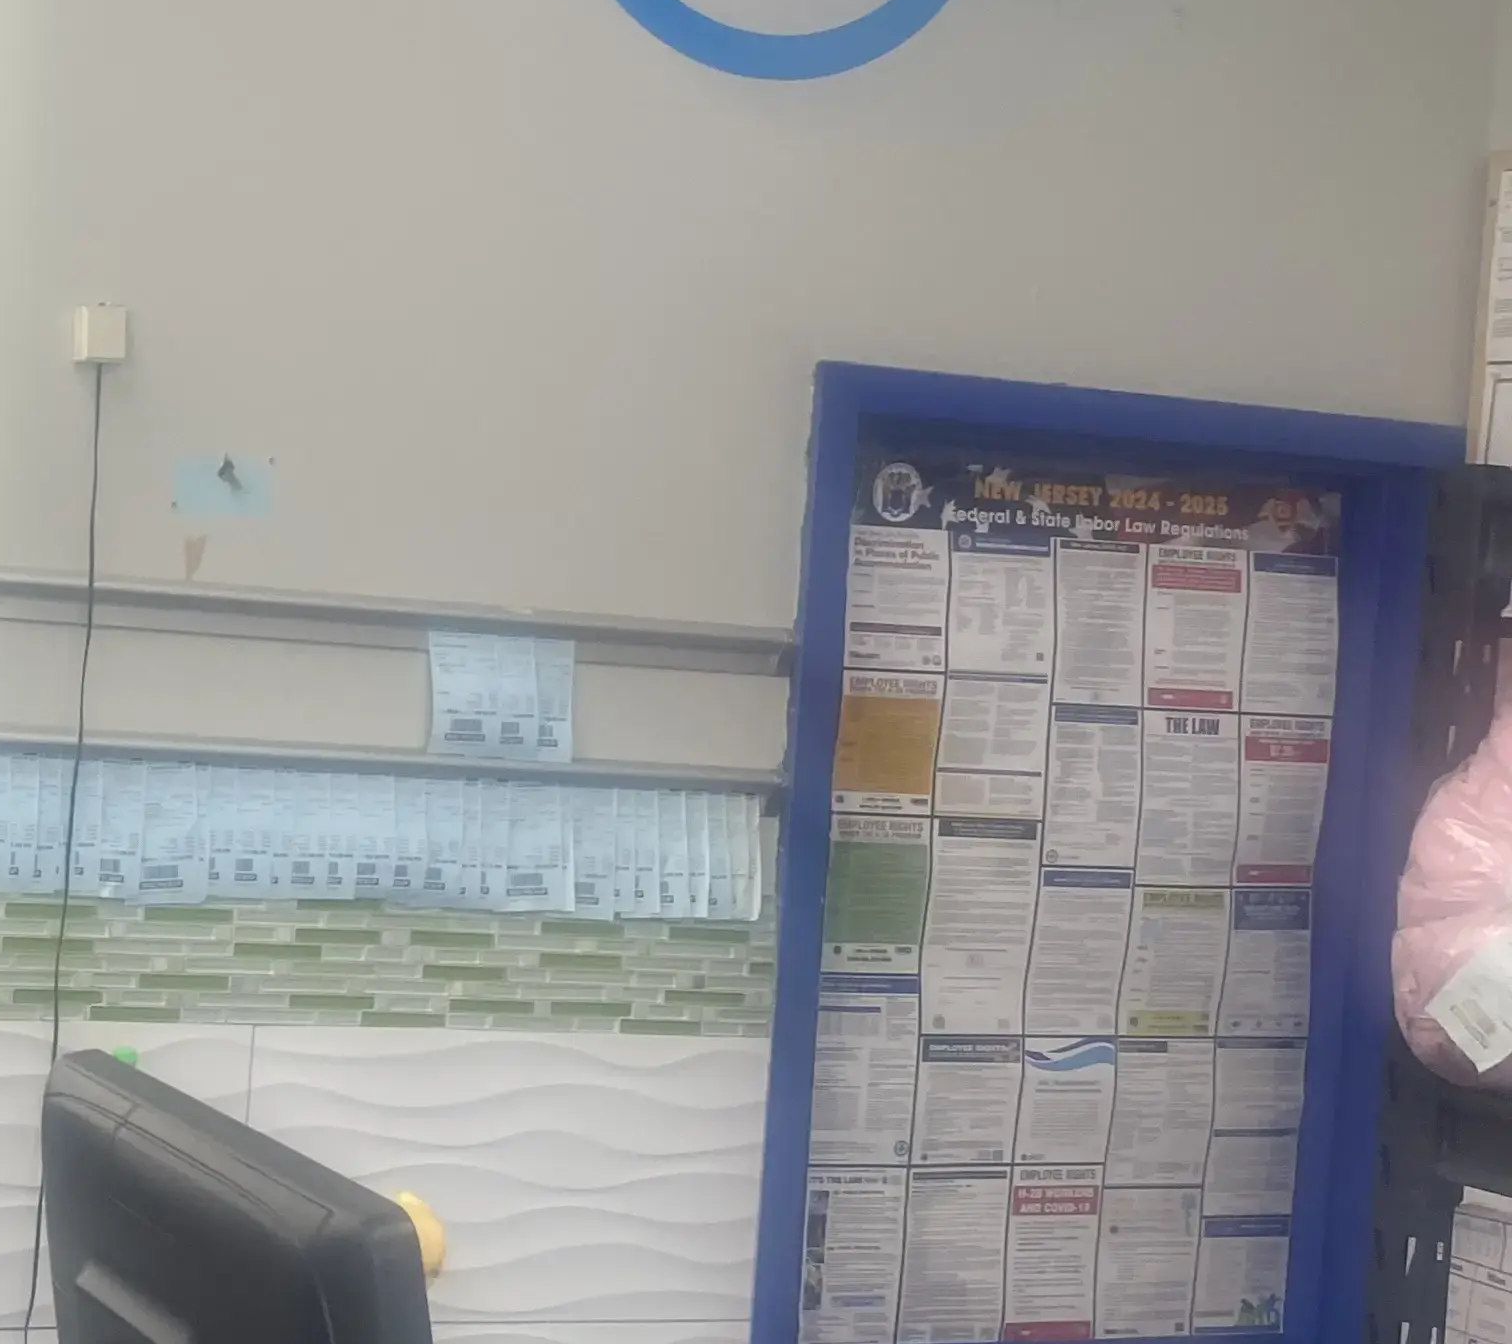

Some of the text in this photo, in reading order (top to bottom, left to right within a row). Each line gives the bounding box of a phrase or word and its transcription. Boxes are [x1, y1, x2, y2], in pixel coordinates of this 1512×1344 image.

[974, 477, 1022, 501] NEW
[1032, 482, 1104, 506] JERSEY
[1109, 489, 1161, 511] 2024
[1180, 492, 1228, 515] 2025
[949, 506, 1249, 541] Federal & State Labor Law Regulations
[1165, 716, 1220, 736] THE LAW
